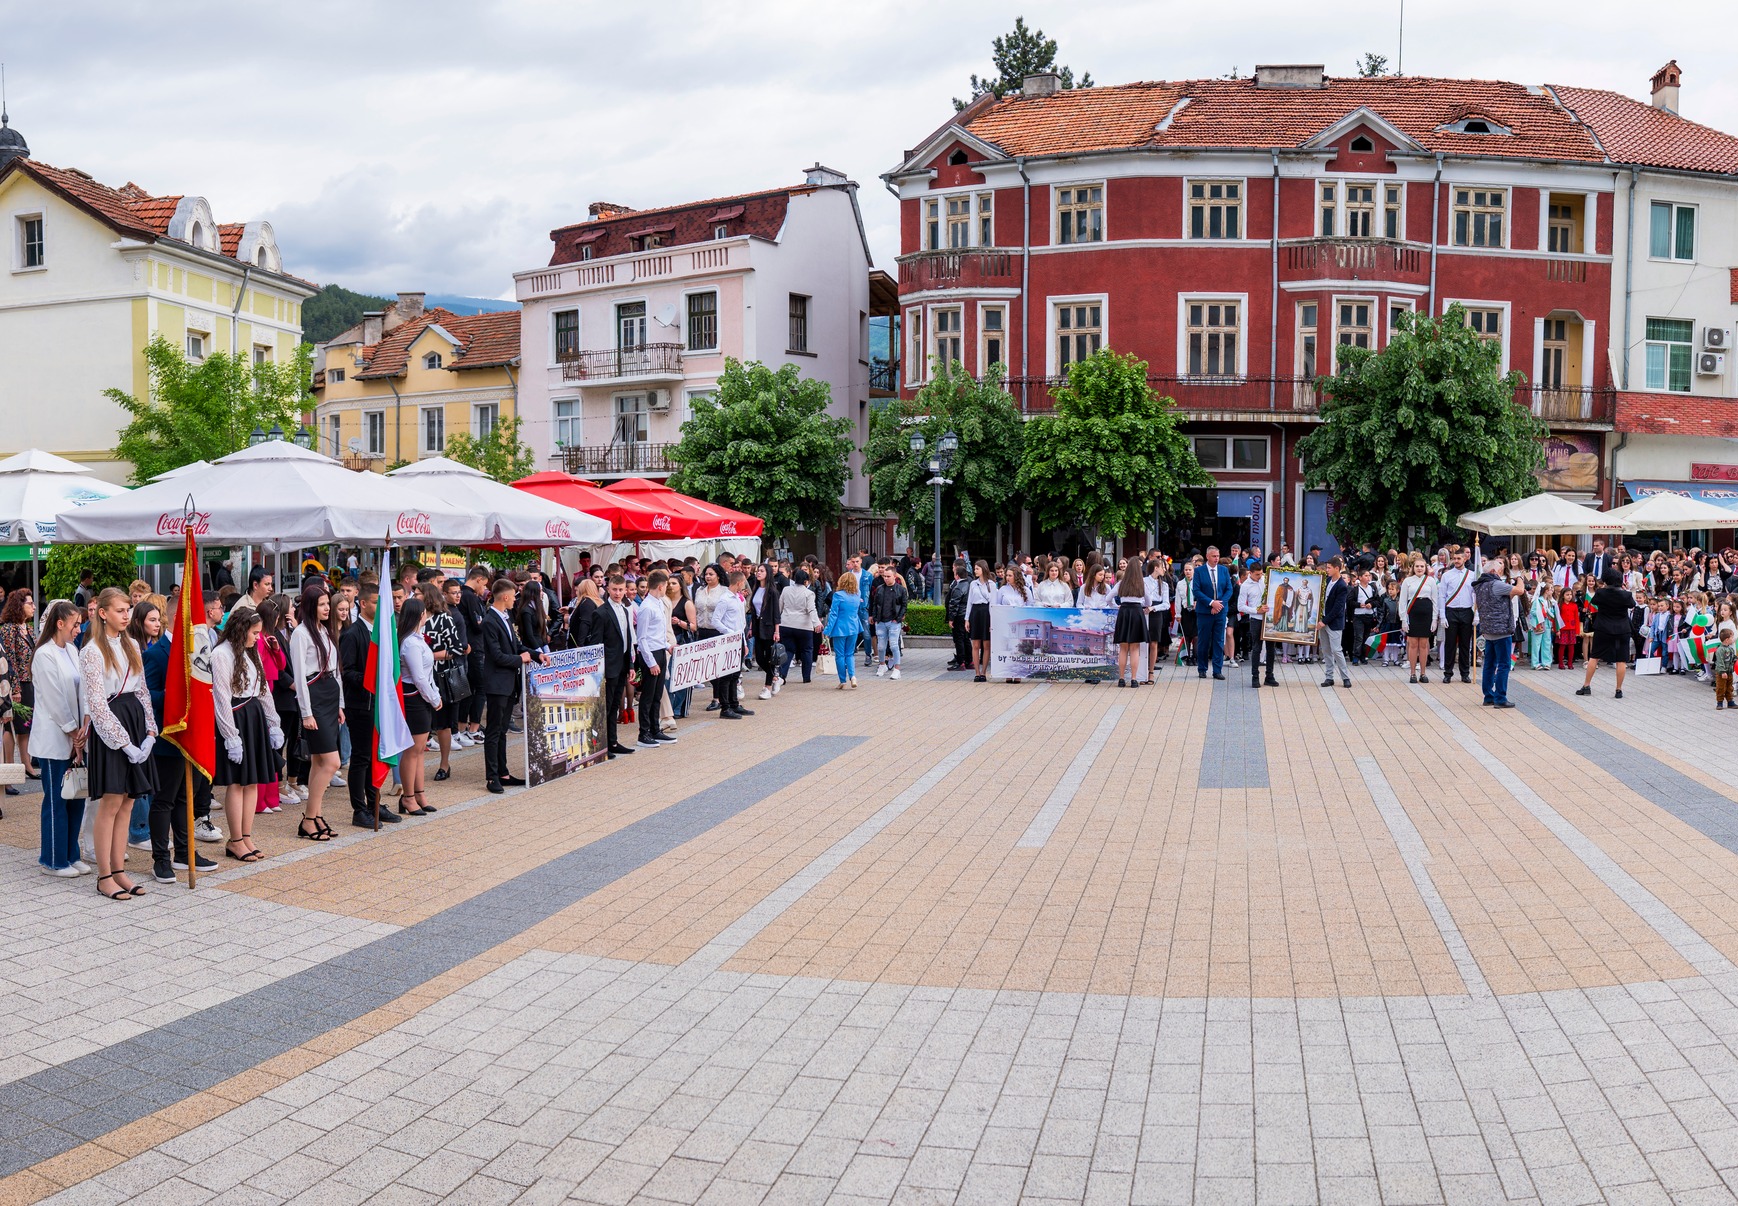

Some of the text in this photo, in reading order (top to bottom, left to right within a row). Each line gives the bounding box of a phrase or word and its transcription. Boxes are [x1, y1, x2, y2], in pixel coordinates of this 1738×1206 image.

[1252, 495, 1263, 535] Стоки
[421, 556, 464, 565] LUNH MENU
[674, 647, 742, 687] ВИПУСК 2025
